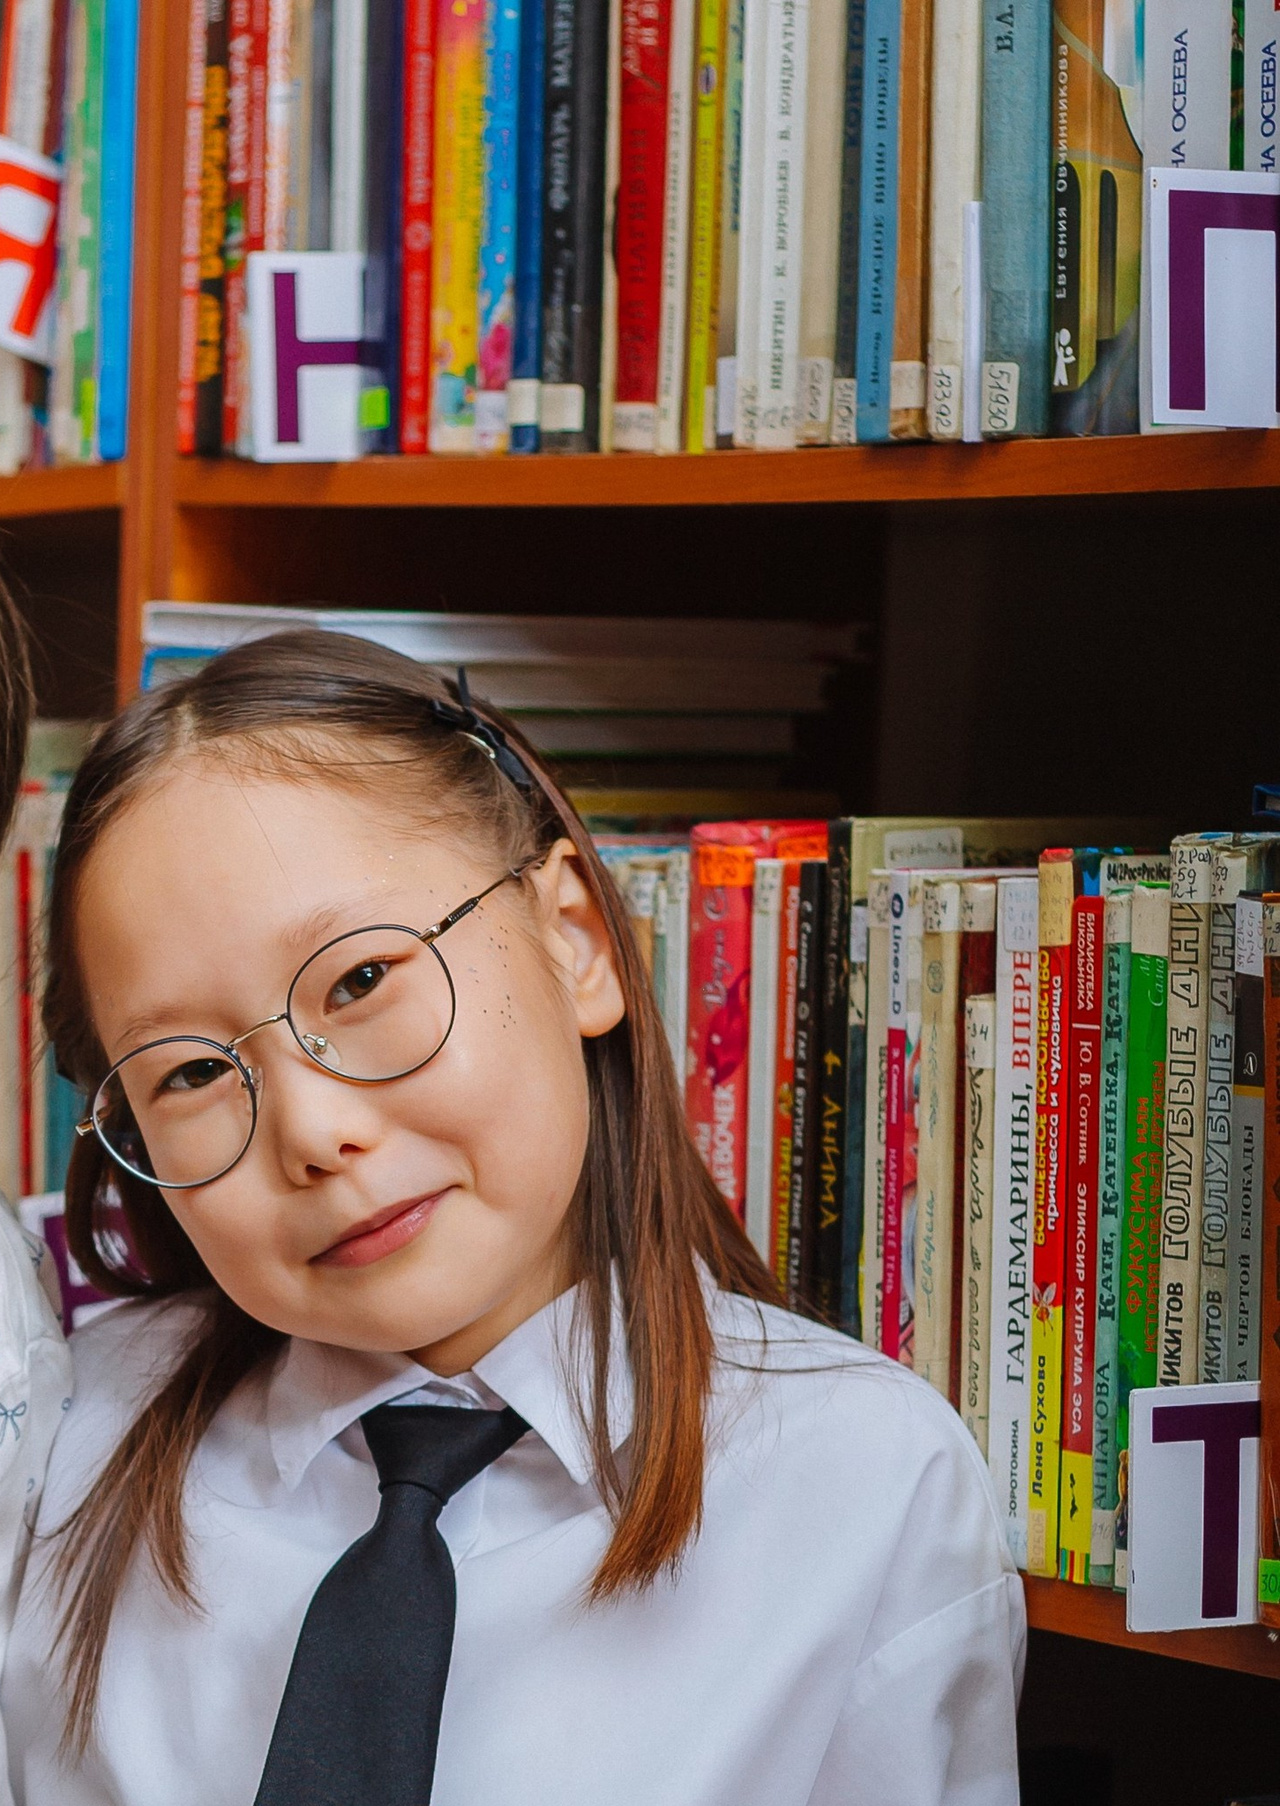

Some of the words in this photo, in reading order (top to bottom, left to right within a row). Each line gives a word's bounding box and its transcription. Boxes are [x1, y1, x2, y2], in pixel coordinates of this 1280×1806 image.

[1057, 44, 1070, 193] Овчинникова
[1172, 28, 1188, 131] ОСЕЕВА
[1261, 40, 1277, 137] ОСЕЕВА
[1056, 207, 1068, 299] Евгения
[986, 364, 1013, 432] 51930
[1077, 912, 1087, 1011] ШКОЛЬНИКА
[1086, 912, 1096, 1011] БИБЛИОТЕКА
[1169, 902, 1203, 1008] ДНИ
[1210, 902, 1236, 1016] ДНИ
[1048, 975, 1064, 1084] чудовища
[1078, 1041, 1092, 1064] Ю.
[1047, 1092, 1058, 1108] и
[1078, 1073, 1092, 1088] В.
[1150, 1061, 1166, 1148] ДРУЖБЫ
[820, 1094, 843, 1230] АНИМА
[1045, 1114, 1062, 1230] принцесса
[1162, 1025, 1197, 1261] ГОЛУБЫЕ
[1201, 1032, 1232, 1269] ГОЛУБЫЕ
[1238, 1124, 1255, 1241] БЛОКАДЫ
[1006, 1083, 1032, 1386] ГАРДЕМАРИНЫ,
[1074, 1182, 1088, 1282] ЭЛИКСИР
[1126, 1151, 1148, 1314] ФУКУСИМА
[1147, 1150, 1163, 1259] СОБАЧЬЕЙ
[1072, 1287, 1085, 1387] КУПРУМА
[1144, 1262, 1160, 1353] ИСТОРИЯ
[1203, 1290, 1223, 1386] ИКИТОВ
[1235, 1254, 1253, 1347] ЧЕРТОЙ
[1033, 1354, 1047, 1436] Сухова
[1070, 1394, 1082, 1435] ЭСА
[1032, 1442, 1044, 1498] Лена
[1152, 1401, 1260, 1619] Т
